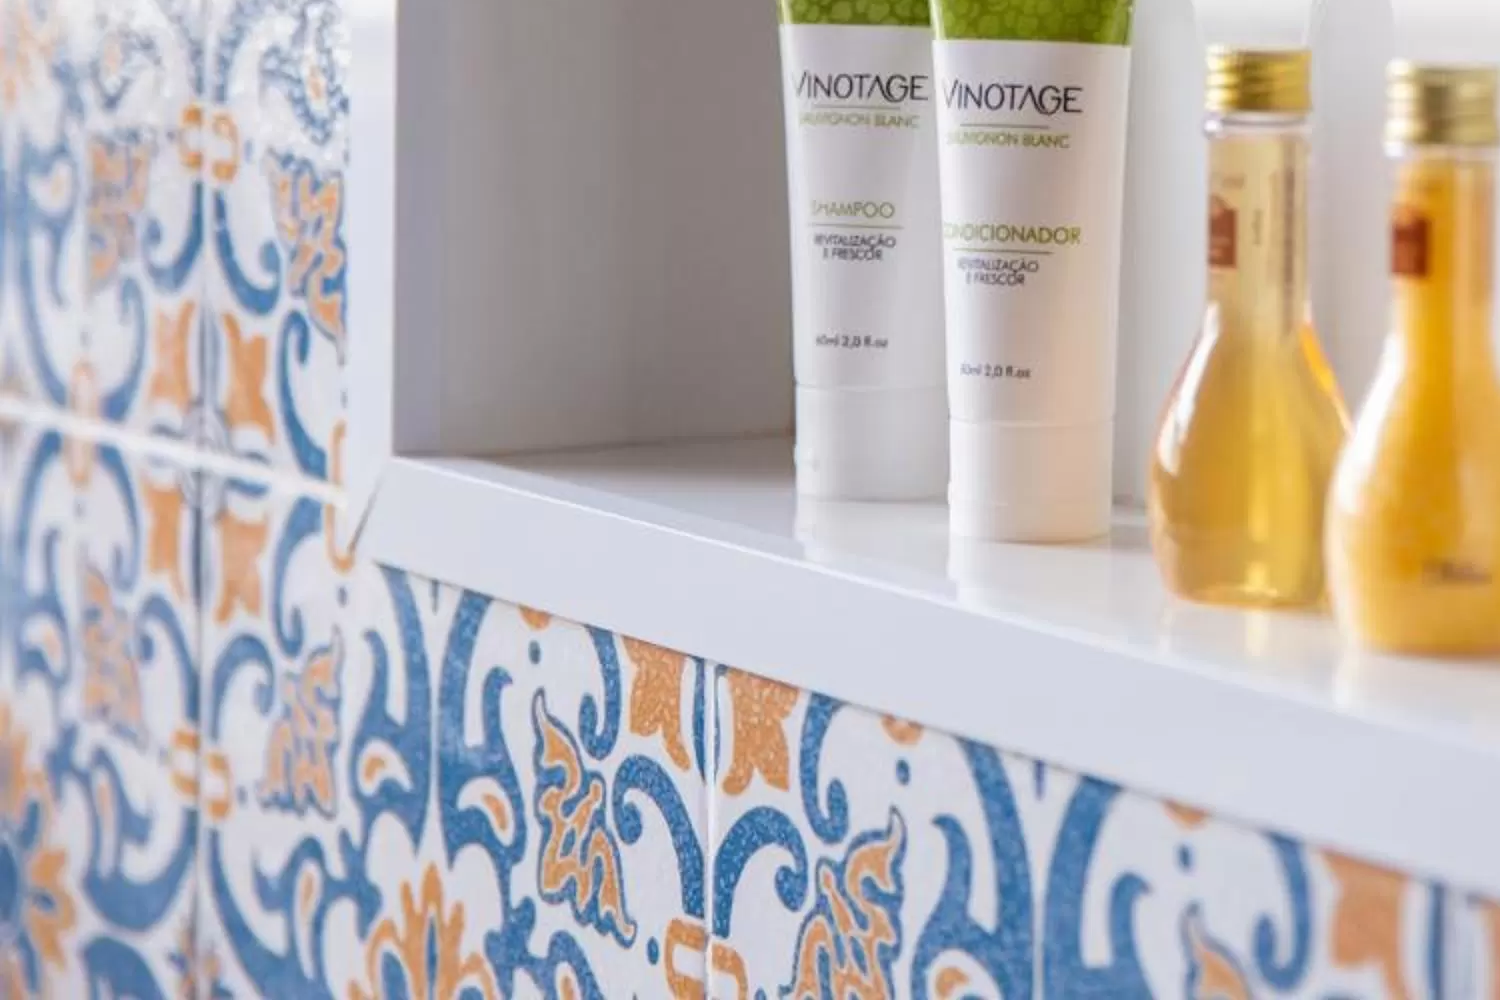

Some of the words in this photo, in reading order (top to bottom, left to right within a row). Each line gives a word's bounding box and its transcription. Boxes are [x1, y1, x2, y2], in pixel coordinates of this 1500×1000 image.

[792, 71, 929, 103] VINOTAGE
[943, 79, 1083, 115] VINOTAGE
[874, 113, 920, 128] BLANC
[1023, 133, 1070, 149] BLANC
[811, 200, 895, 219] SHAMPOO
